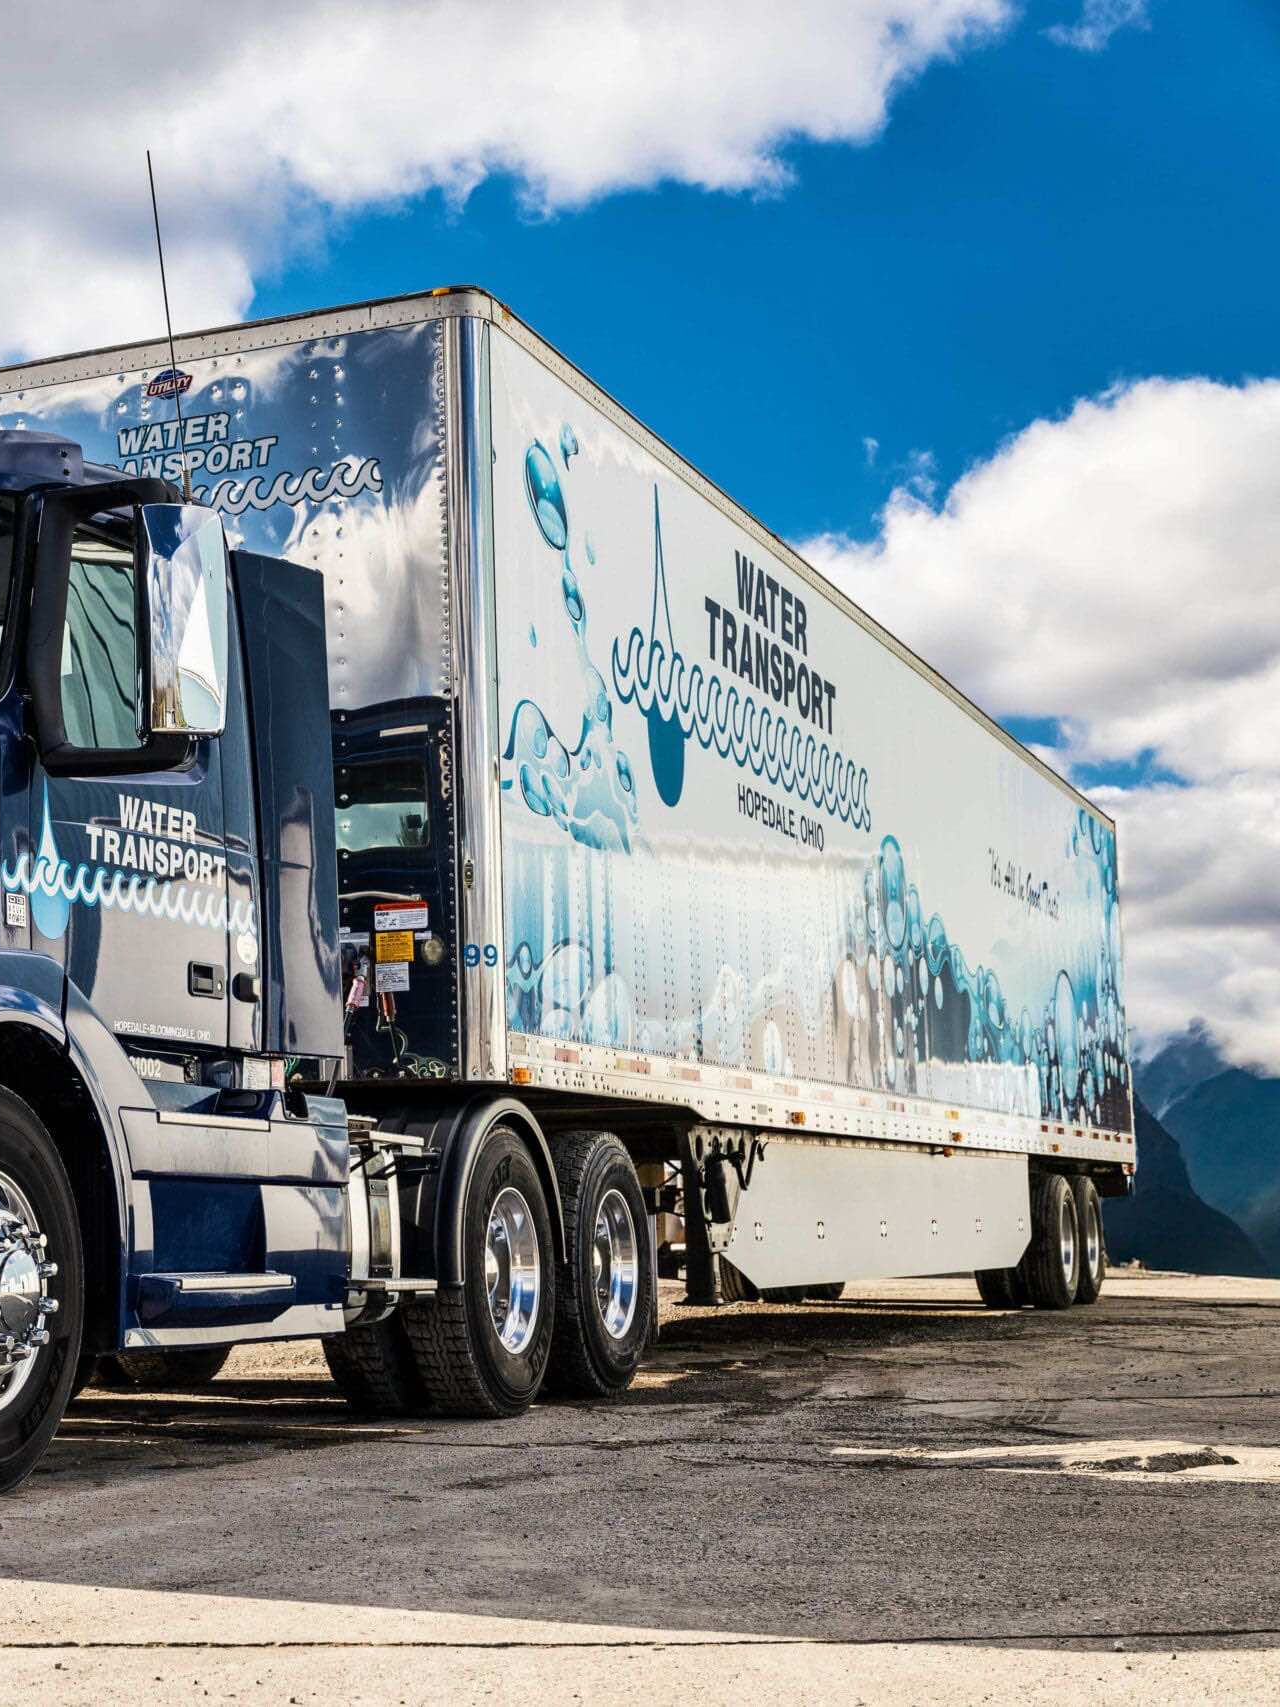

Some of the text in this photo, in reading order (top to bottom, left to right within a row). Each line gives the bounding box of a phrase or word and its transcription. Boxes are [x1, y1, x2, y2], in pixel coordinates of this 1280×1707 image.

[148, 376, 192, 395] UTILITY
[119, 412, 230, 457] WATER
[122, 436, 278, 482] ANSPORT
[735, 549, 807, 657] WATER
[704, 595, 836, 735] TRANSPORT
[119, 794, 197, 844] WATER
[737, 783, 824, 852] HOPEDALE, OHIO
[85, 825, 228, 889] TRANSPORT
